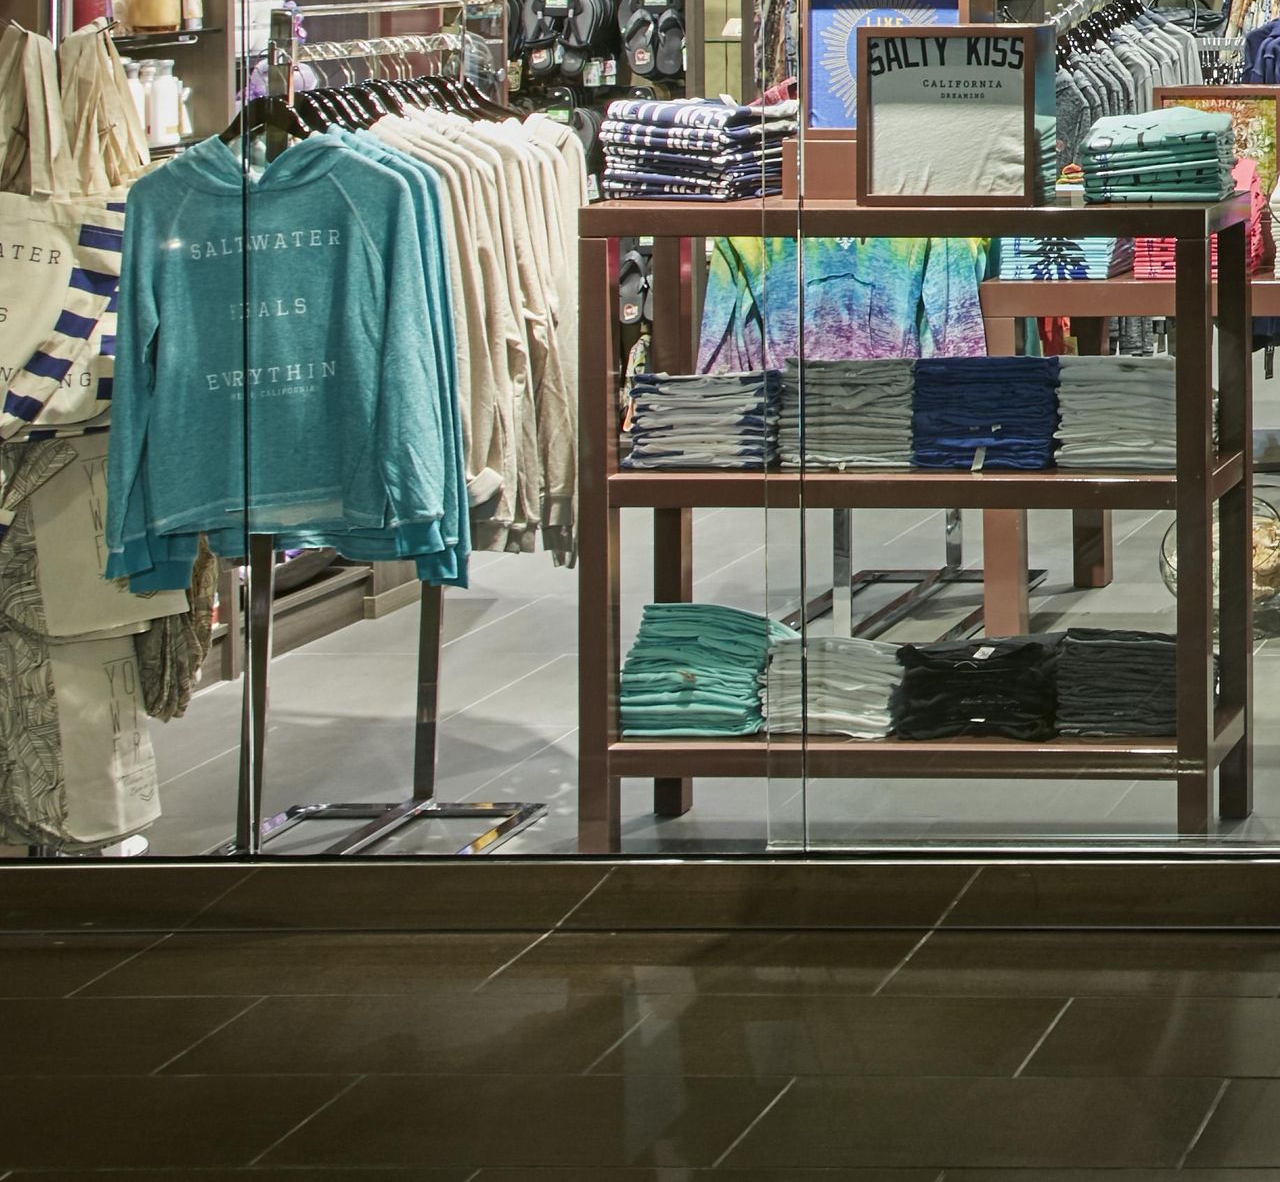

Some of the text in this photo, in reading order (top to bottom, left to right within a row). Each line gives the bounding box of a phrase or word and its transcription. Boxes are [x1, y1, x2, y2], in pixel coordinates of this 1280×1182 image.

[870, 37, 1024, 76] SALTY KISS
[922, 78, 1003, 89] CALIFORNIA
[190, 229, 341, 260] SALTWATER
